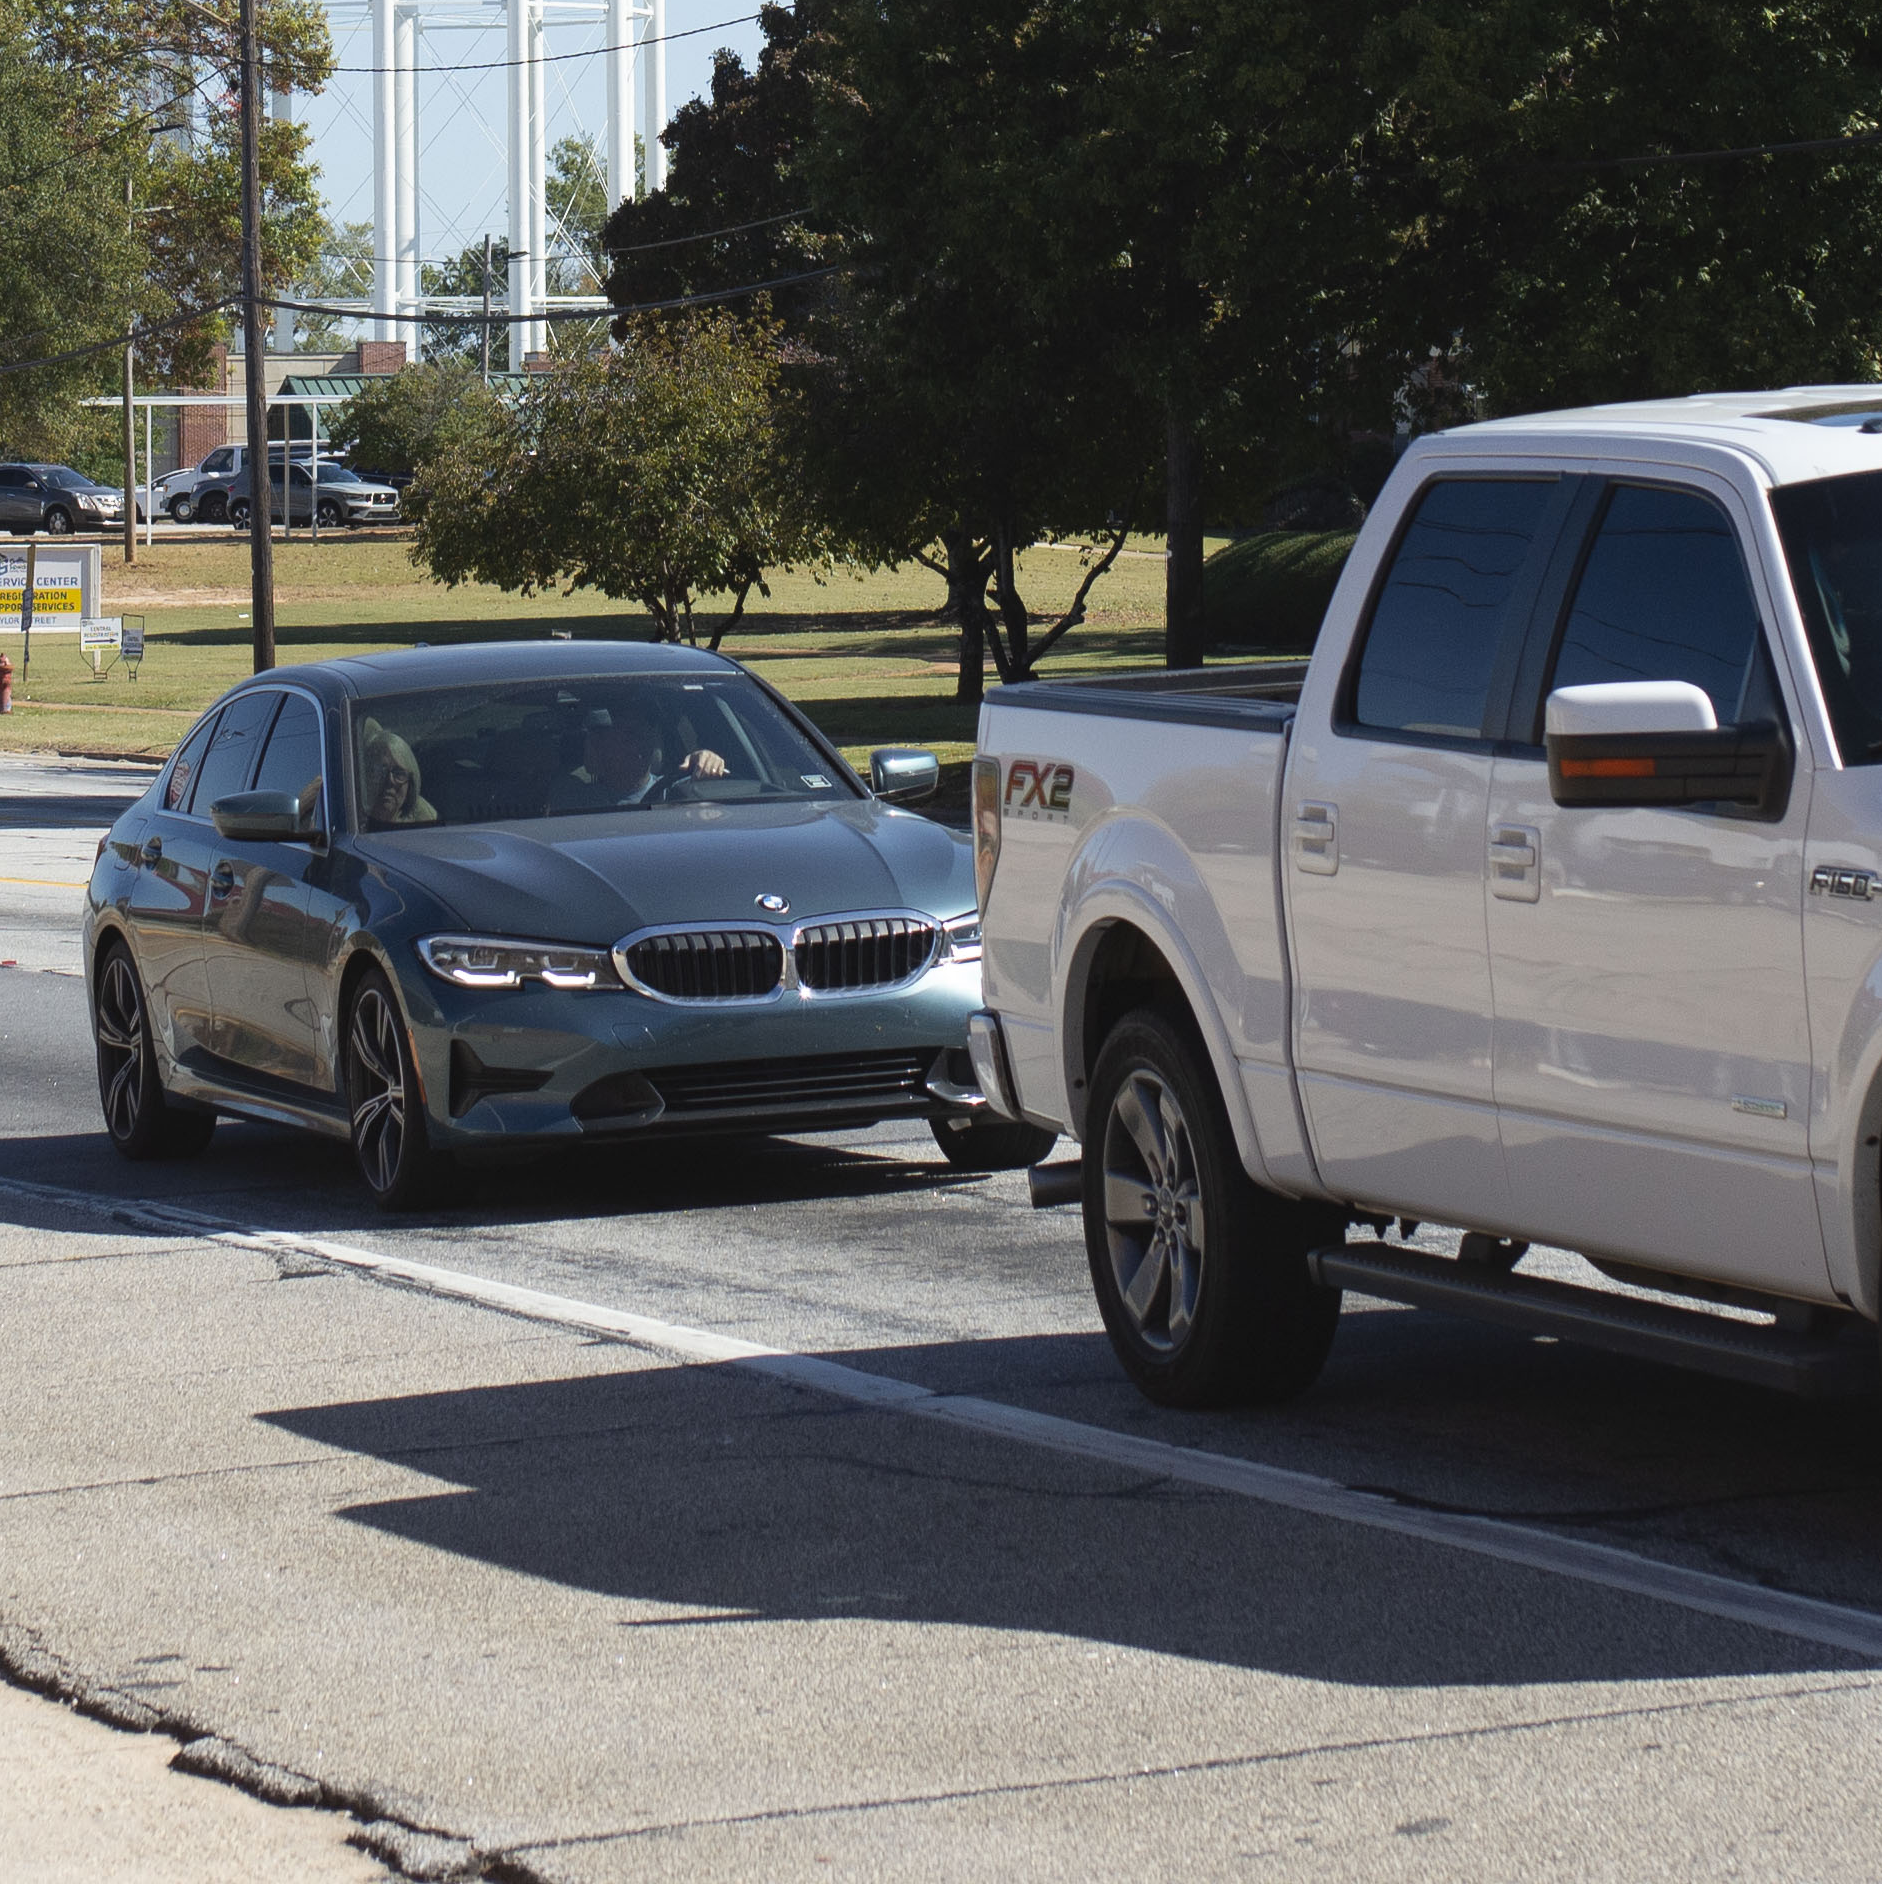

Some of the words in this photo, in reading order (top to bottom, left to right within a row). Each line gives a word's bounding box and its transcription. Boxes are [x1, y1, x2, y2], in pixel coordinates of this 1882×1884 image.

[36, 576, 79, 586] CENTER
[0, 591, 68, 601] REGIRATION
[31, 616, 57, 624] REET
[1004, 759, 1075, 812] FX2
